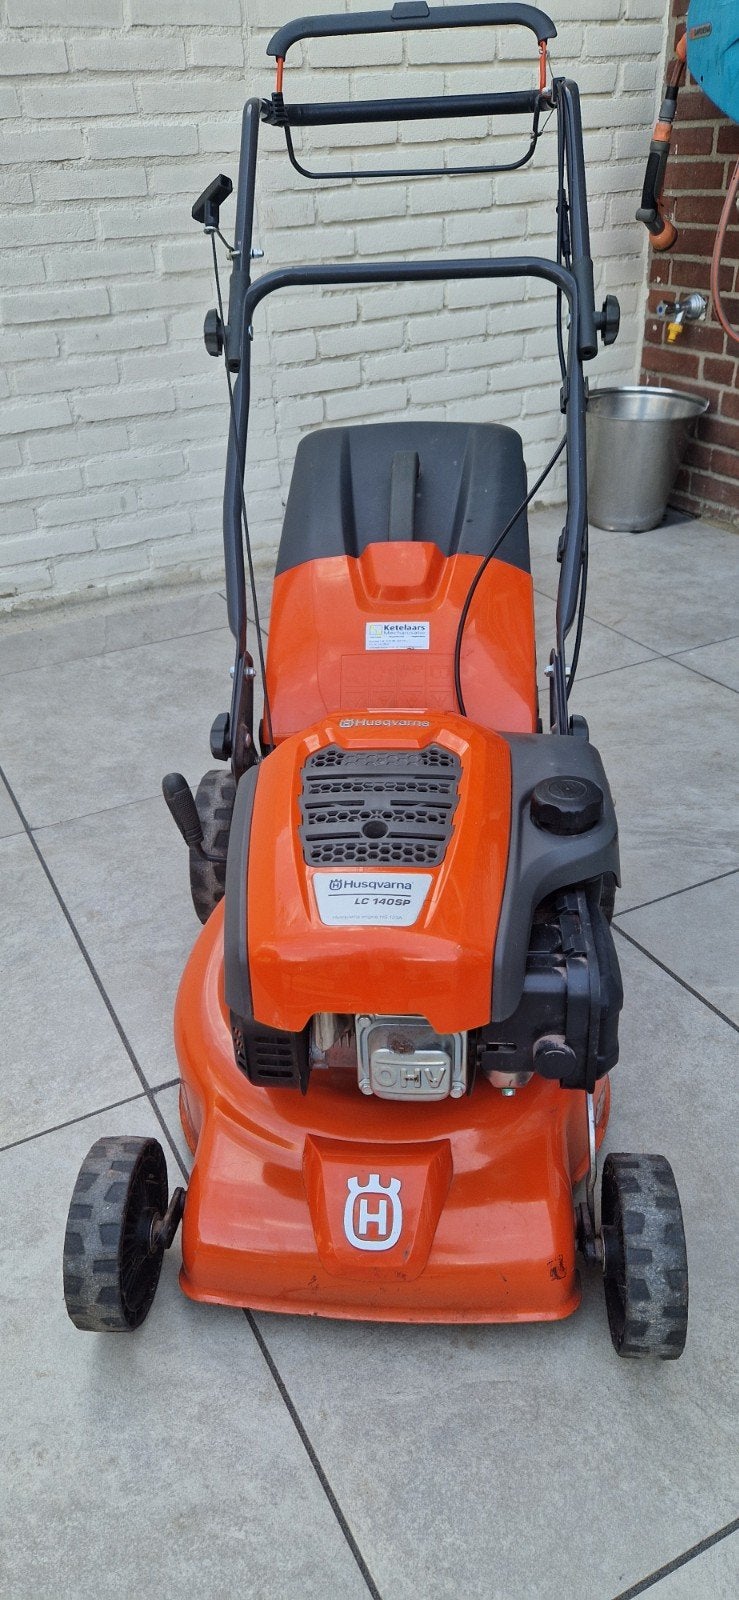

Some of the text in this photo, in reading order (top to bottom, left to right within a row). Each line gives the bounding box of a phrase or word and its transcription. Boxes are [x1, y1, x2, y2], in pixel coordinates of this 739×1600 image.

[355, 719, 430, 728] Husqvarna
[343, 880, 412, 890] Husqvarna
[372, 898, 411, 906] 140SP
[374, 1067, 447, 1088] OHV
